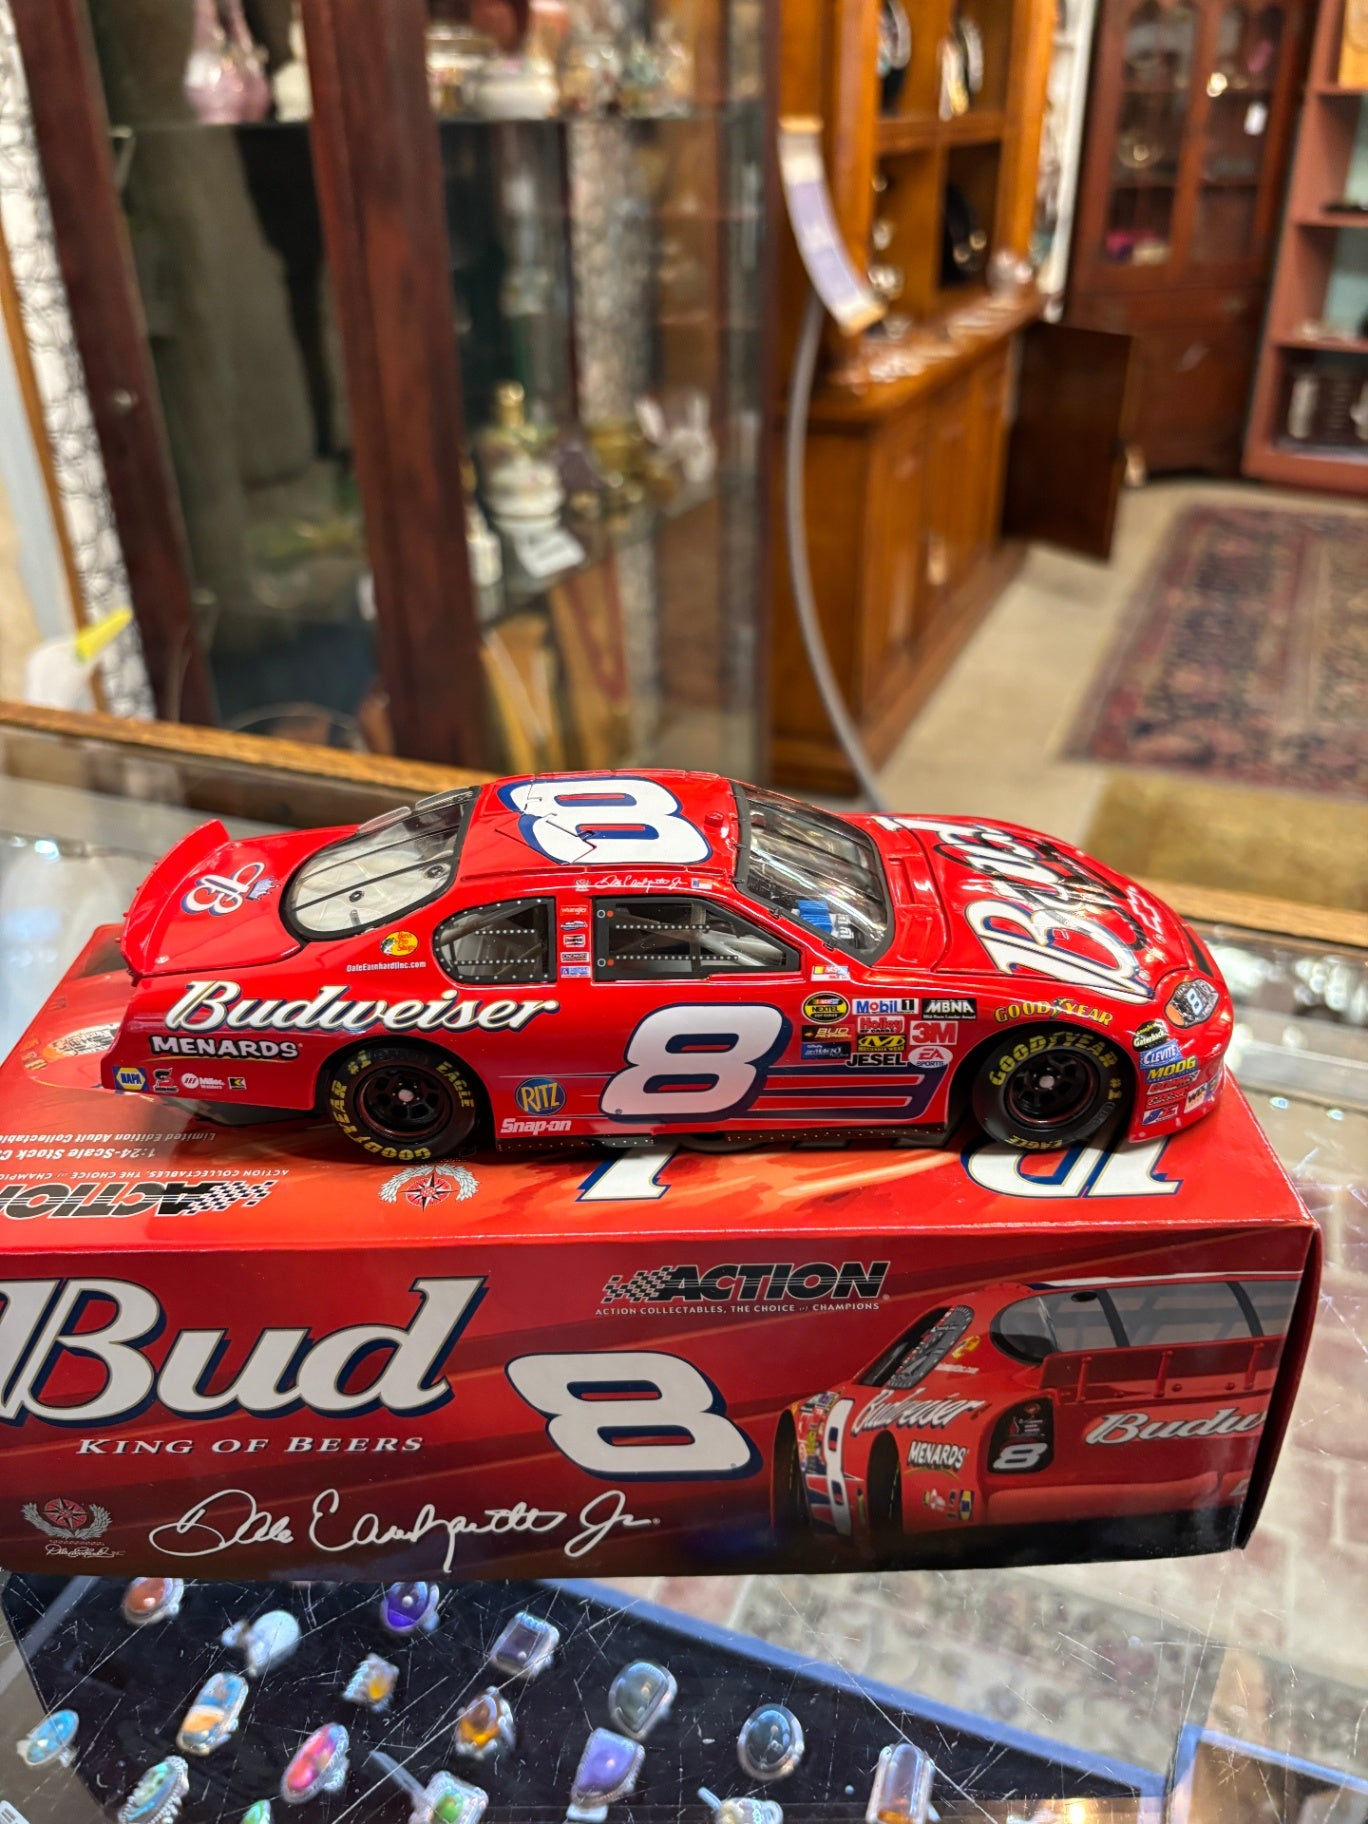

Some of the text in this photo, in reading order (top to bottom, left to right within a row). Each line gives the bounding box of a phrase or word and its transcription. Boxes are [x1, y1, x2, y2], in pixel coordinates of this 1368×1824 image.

[498, 776, 713, 865] 8
[164, 980, 561, 1033] Budweiser
[856, 999, 915, 1013] Mobil 1
[925, 1000, 976, 1013] MBNA
[994, 998, 1113, 1026] GOODYEAR
[911, 1021, 956, 1044] 3M
[151, 1035, 300, 1059] MENARDS
[918, 1048, 944, 1060] EA
[1143, 1044, 1177, 1065] CLEVITE
[599, 1002, 793, 1125] 8
[846, 1053, 907, 1067] JESEL
[989, 1031, 1119, 1086] GOODYEAR
[1149, 1055, 1197, 1080] MOOG
[120, 1072, 143, 1085] NAPA
[436, 1061, 475, 1108] EAGLE
[520, 1082, 561, 1112] RITZ
[330, 1080, 431, 1161] GOODYEAR
[500, 1117, 572, 1136] Snap-on
[74, 1134, 112, 1142] Adult
[114, 1133, 161, 1141] Edition
[165, 1132, 217, 1141] Limited
[1004, 1134, 1063, 1150] EAGLE
[16, 1149, 65, 1160] Stock
[67, 1147, 156, 1159] 1:24-Scale
[71, 1171, 116, 1179] CHOICE
[146, 1170, 240, 1178] COLLECTABLES,
[243, 1169, 290, 1177] ACTION
[645, 1261, 891, 1302] ACTION
[640, 1305, 727, 1314] COLLECTABLES,
[730, 1305, 751, 1313] THE
[753, 1304, 795, 1313] CHOICE
[812, 1302, 880, 1311] CHAMPIONS
[0, 1275, 488, 1428] Bud
[507, 1351, 759, 1481] 8
[851, 1387, 987, 1437] Budweiser
[76, 1436, 425, 1455] KING OF BEERS
[907, 1440, 964, 1472] MENARDS
[992, 1442, 1049, 1470] 8
